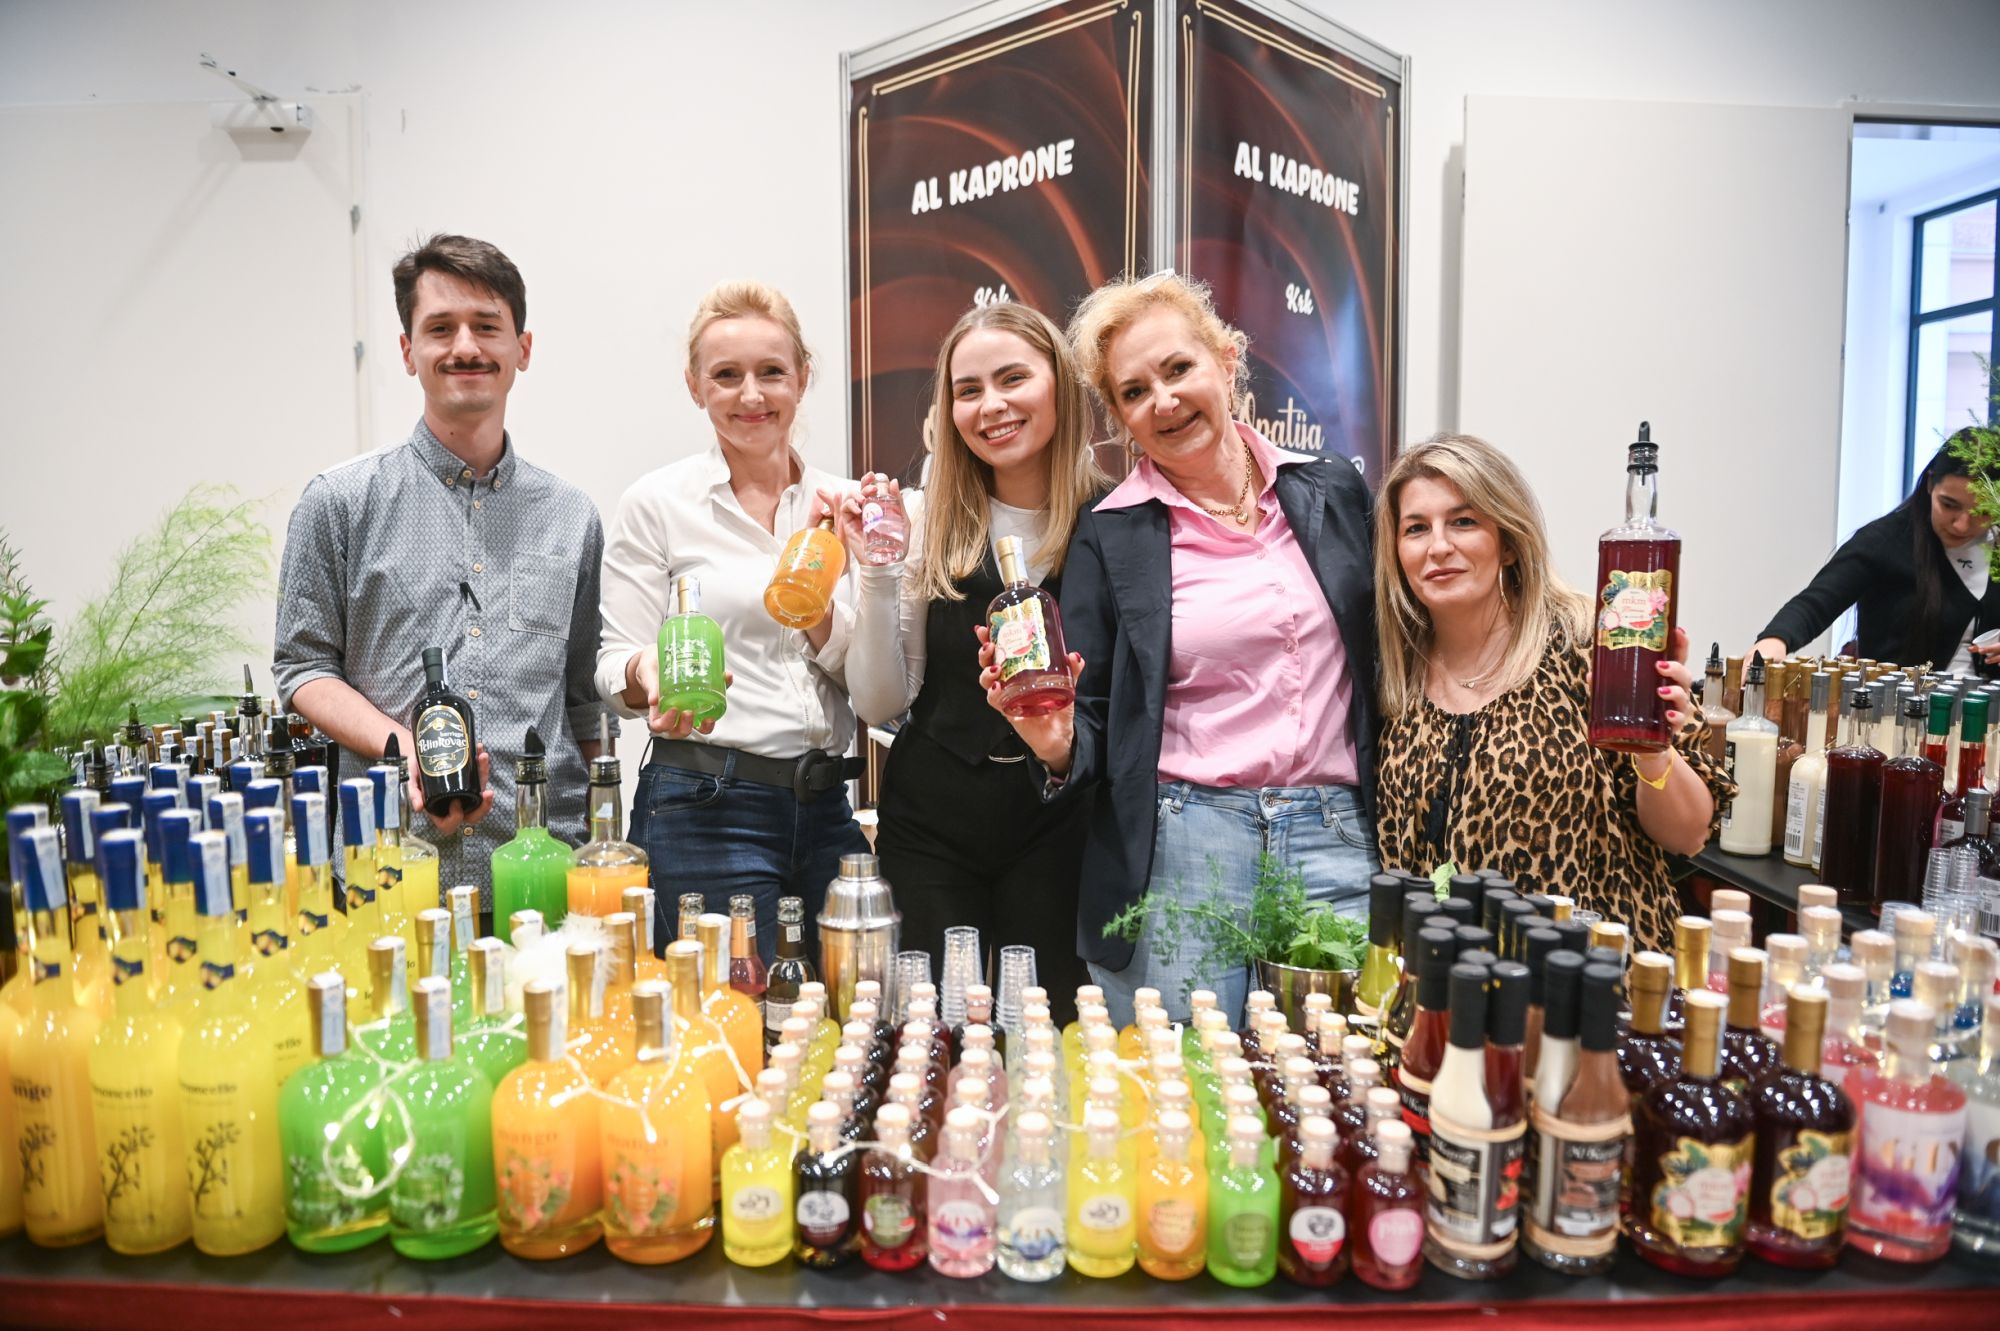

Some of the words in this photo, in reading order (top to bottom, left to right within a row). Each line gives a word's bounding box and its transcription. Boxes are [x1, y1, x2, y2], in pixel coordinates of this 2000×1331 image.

[911, 176, 943, 215] AL
[949, 138, 1075, 206] KAPRONE
[1234, 141, 1264, 182] AL
[1269, 152, 1360, 216] KAPRONE
